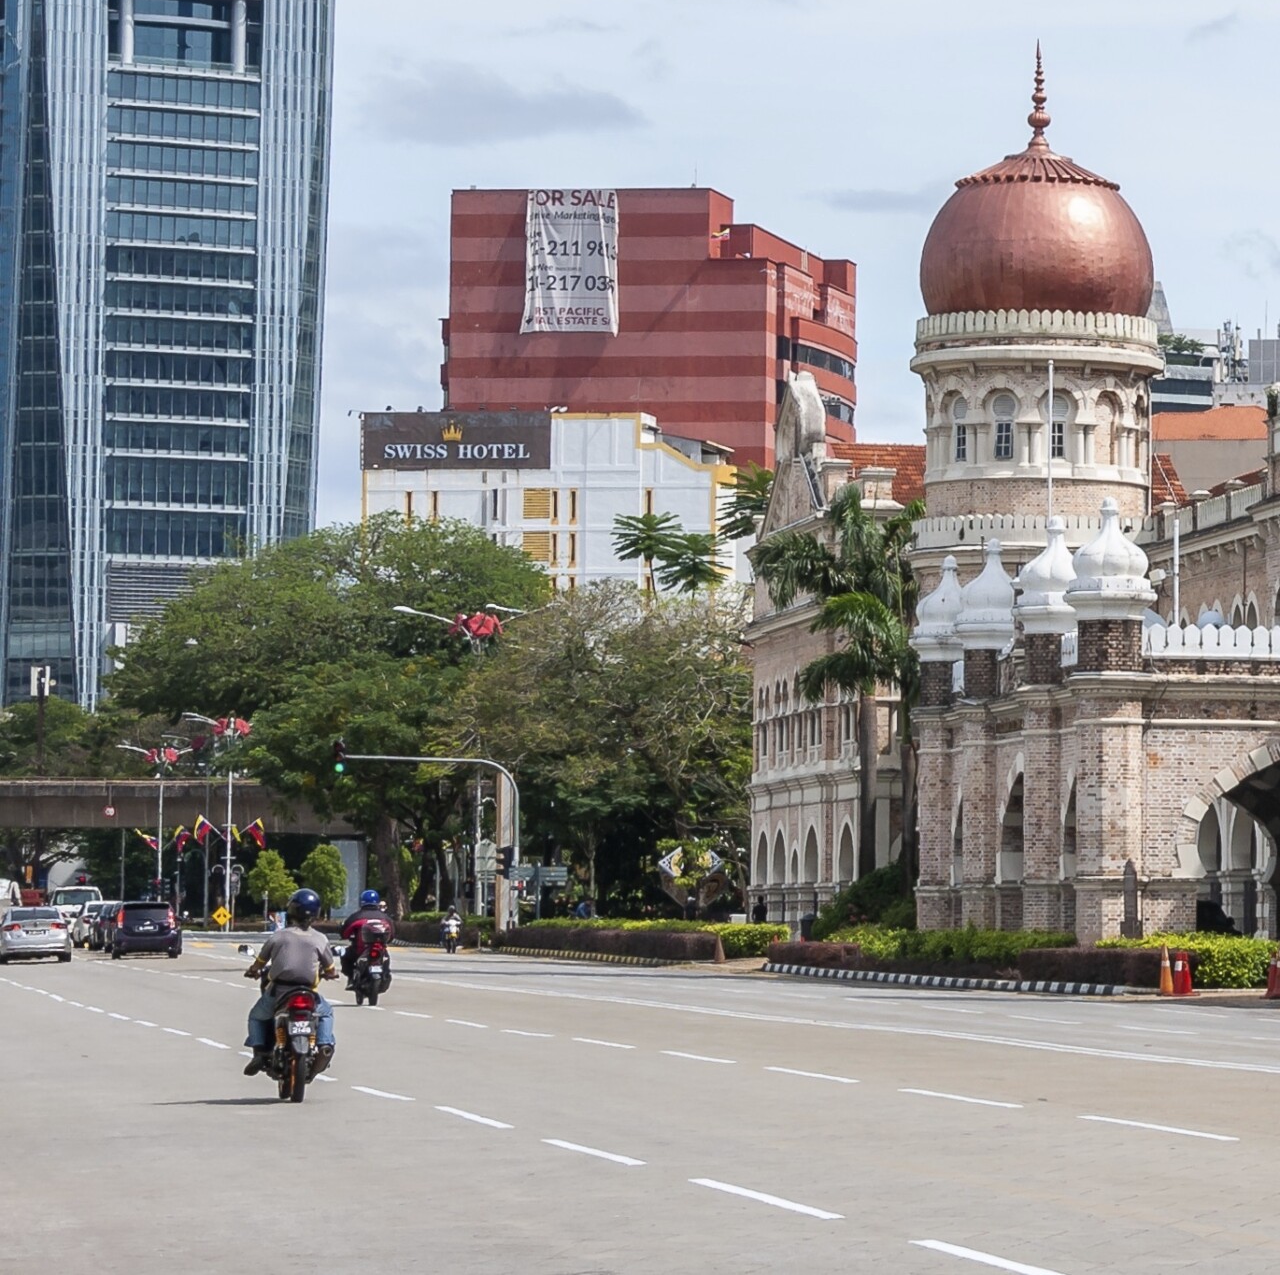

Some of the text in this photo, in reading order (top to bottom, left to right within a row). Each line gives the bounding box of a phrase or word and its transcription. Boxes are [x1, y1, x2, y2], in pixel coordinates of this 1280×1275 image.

[570, 189, 615, 210] SALE
[558, 307, 605, 316] PACIFIC
[557, 317, 598, 325] ESTATE
[384, 443, 531, 459] SWISS HOTEL
